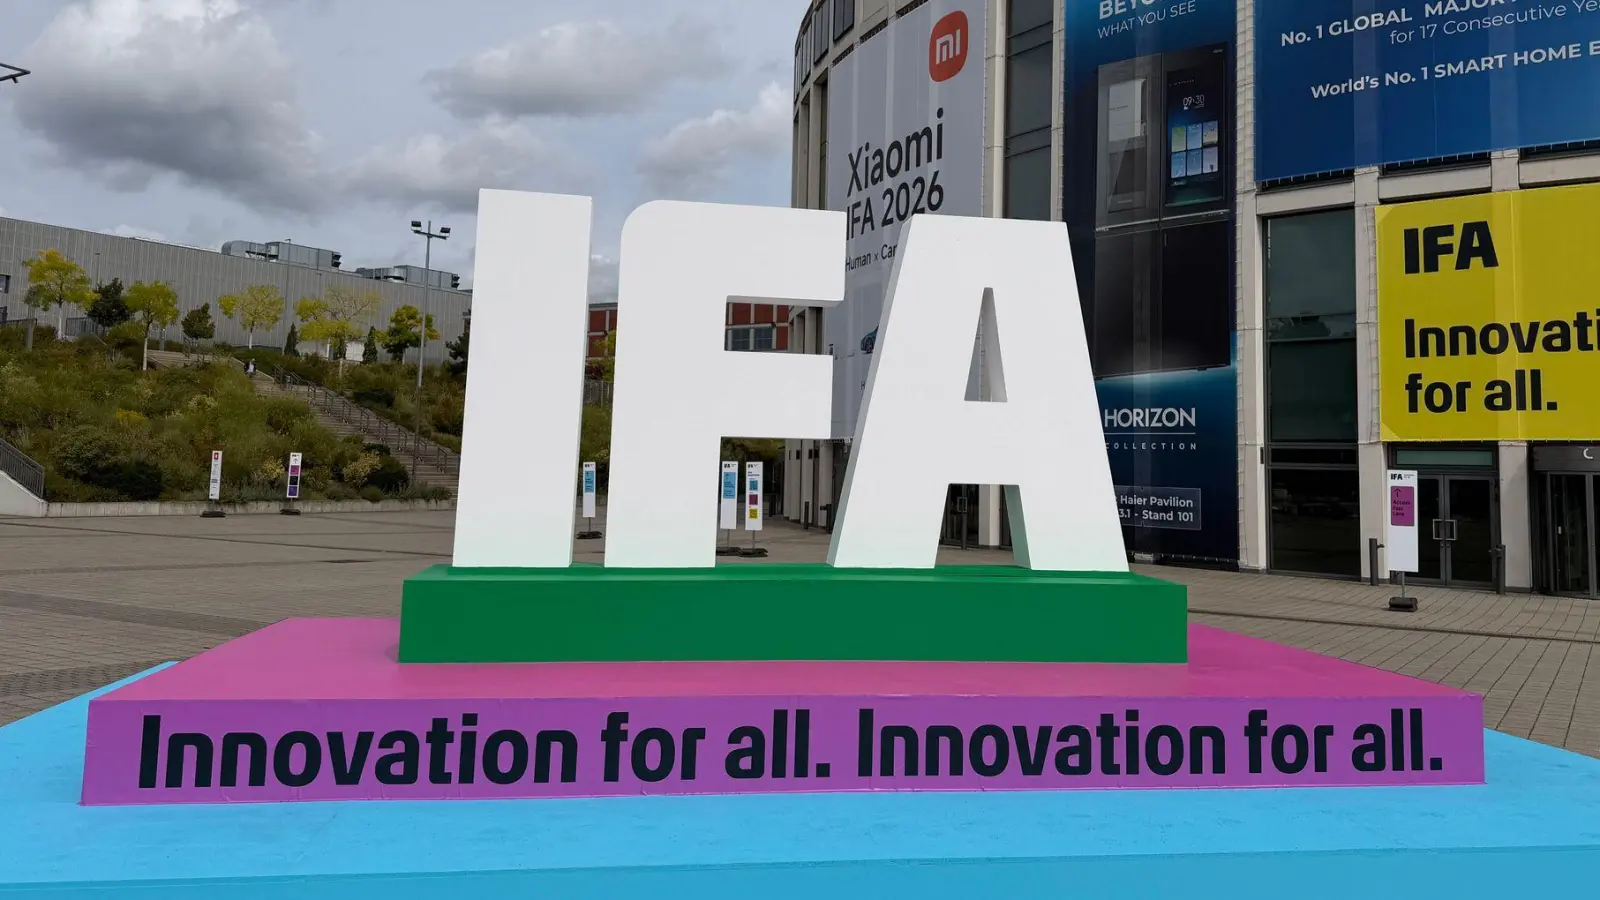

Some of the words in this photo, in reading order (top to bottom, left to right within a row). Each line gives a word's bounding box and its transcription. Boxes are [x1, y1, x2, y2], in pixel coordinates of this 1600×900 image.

[1097, 17, 1135, 39] WHAT
[1138, 8, 1166, 26] YOU
[1170, 0, 1196, 18] SEE
[1099, 0, 1155, 20] BE
[1281, 31, 1311, 46] No.
[1315, 24, 1324, 39] 1
[1328, 7, 1413, 34] GLOBAL
[1390, 29, 1415, 45] for
[1419, 23, 1438, 39] 17
[1443, 4, 1567, 35] Consecutive
[1572, 0, 1600, 14] Ye
[1310, 75, 1380, 99] World's
[1385, 70, 1416, 87] No.
[1420, 66, 1428, 81] 1
[1434, 54, 1507, 79] SMART
[1513, 42, 1582, 67] HOME
[847, 107, 944, 198] Xiaomi
[846, 196, 875, 241] IFA
[881, 170, 944, 228] 2026
[845, 252, 871, 273] Human
[881, 244, 898, 260] Car
[1404, 220, 1499, 274] IFA
[452, 188, 1130, 571] IFA
[1405, 373, 1472, 413] for
[1484, 369, 1558, 411] all.
[1104, 407, 1196, 427] HORIZON
[1120, 495, 1147, 506] Haier
[1149, 496, 1194, 508] Pavilion
[1142, 509, 1174, 521] Stand
[1177, 511, 1194, 522] 101
[138, 714, 579, 788] Innovation
[601, 711, 706, 782] for
[725, 708, 831, 780] all.
[857, 708, 1226, 777] Innovation
[1244, 709, 1334, 774] for
[1352, 708, 1443, 772] all.
